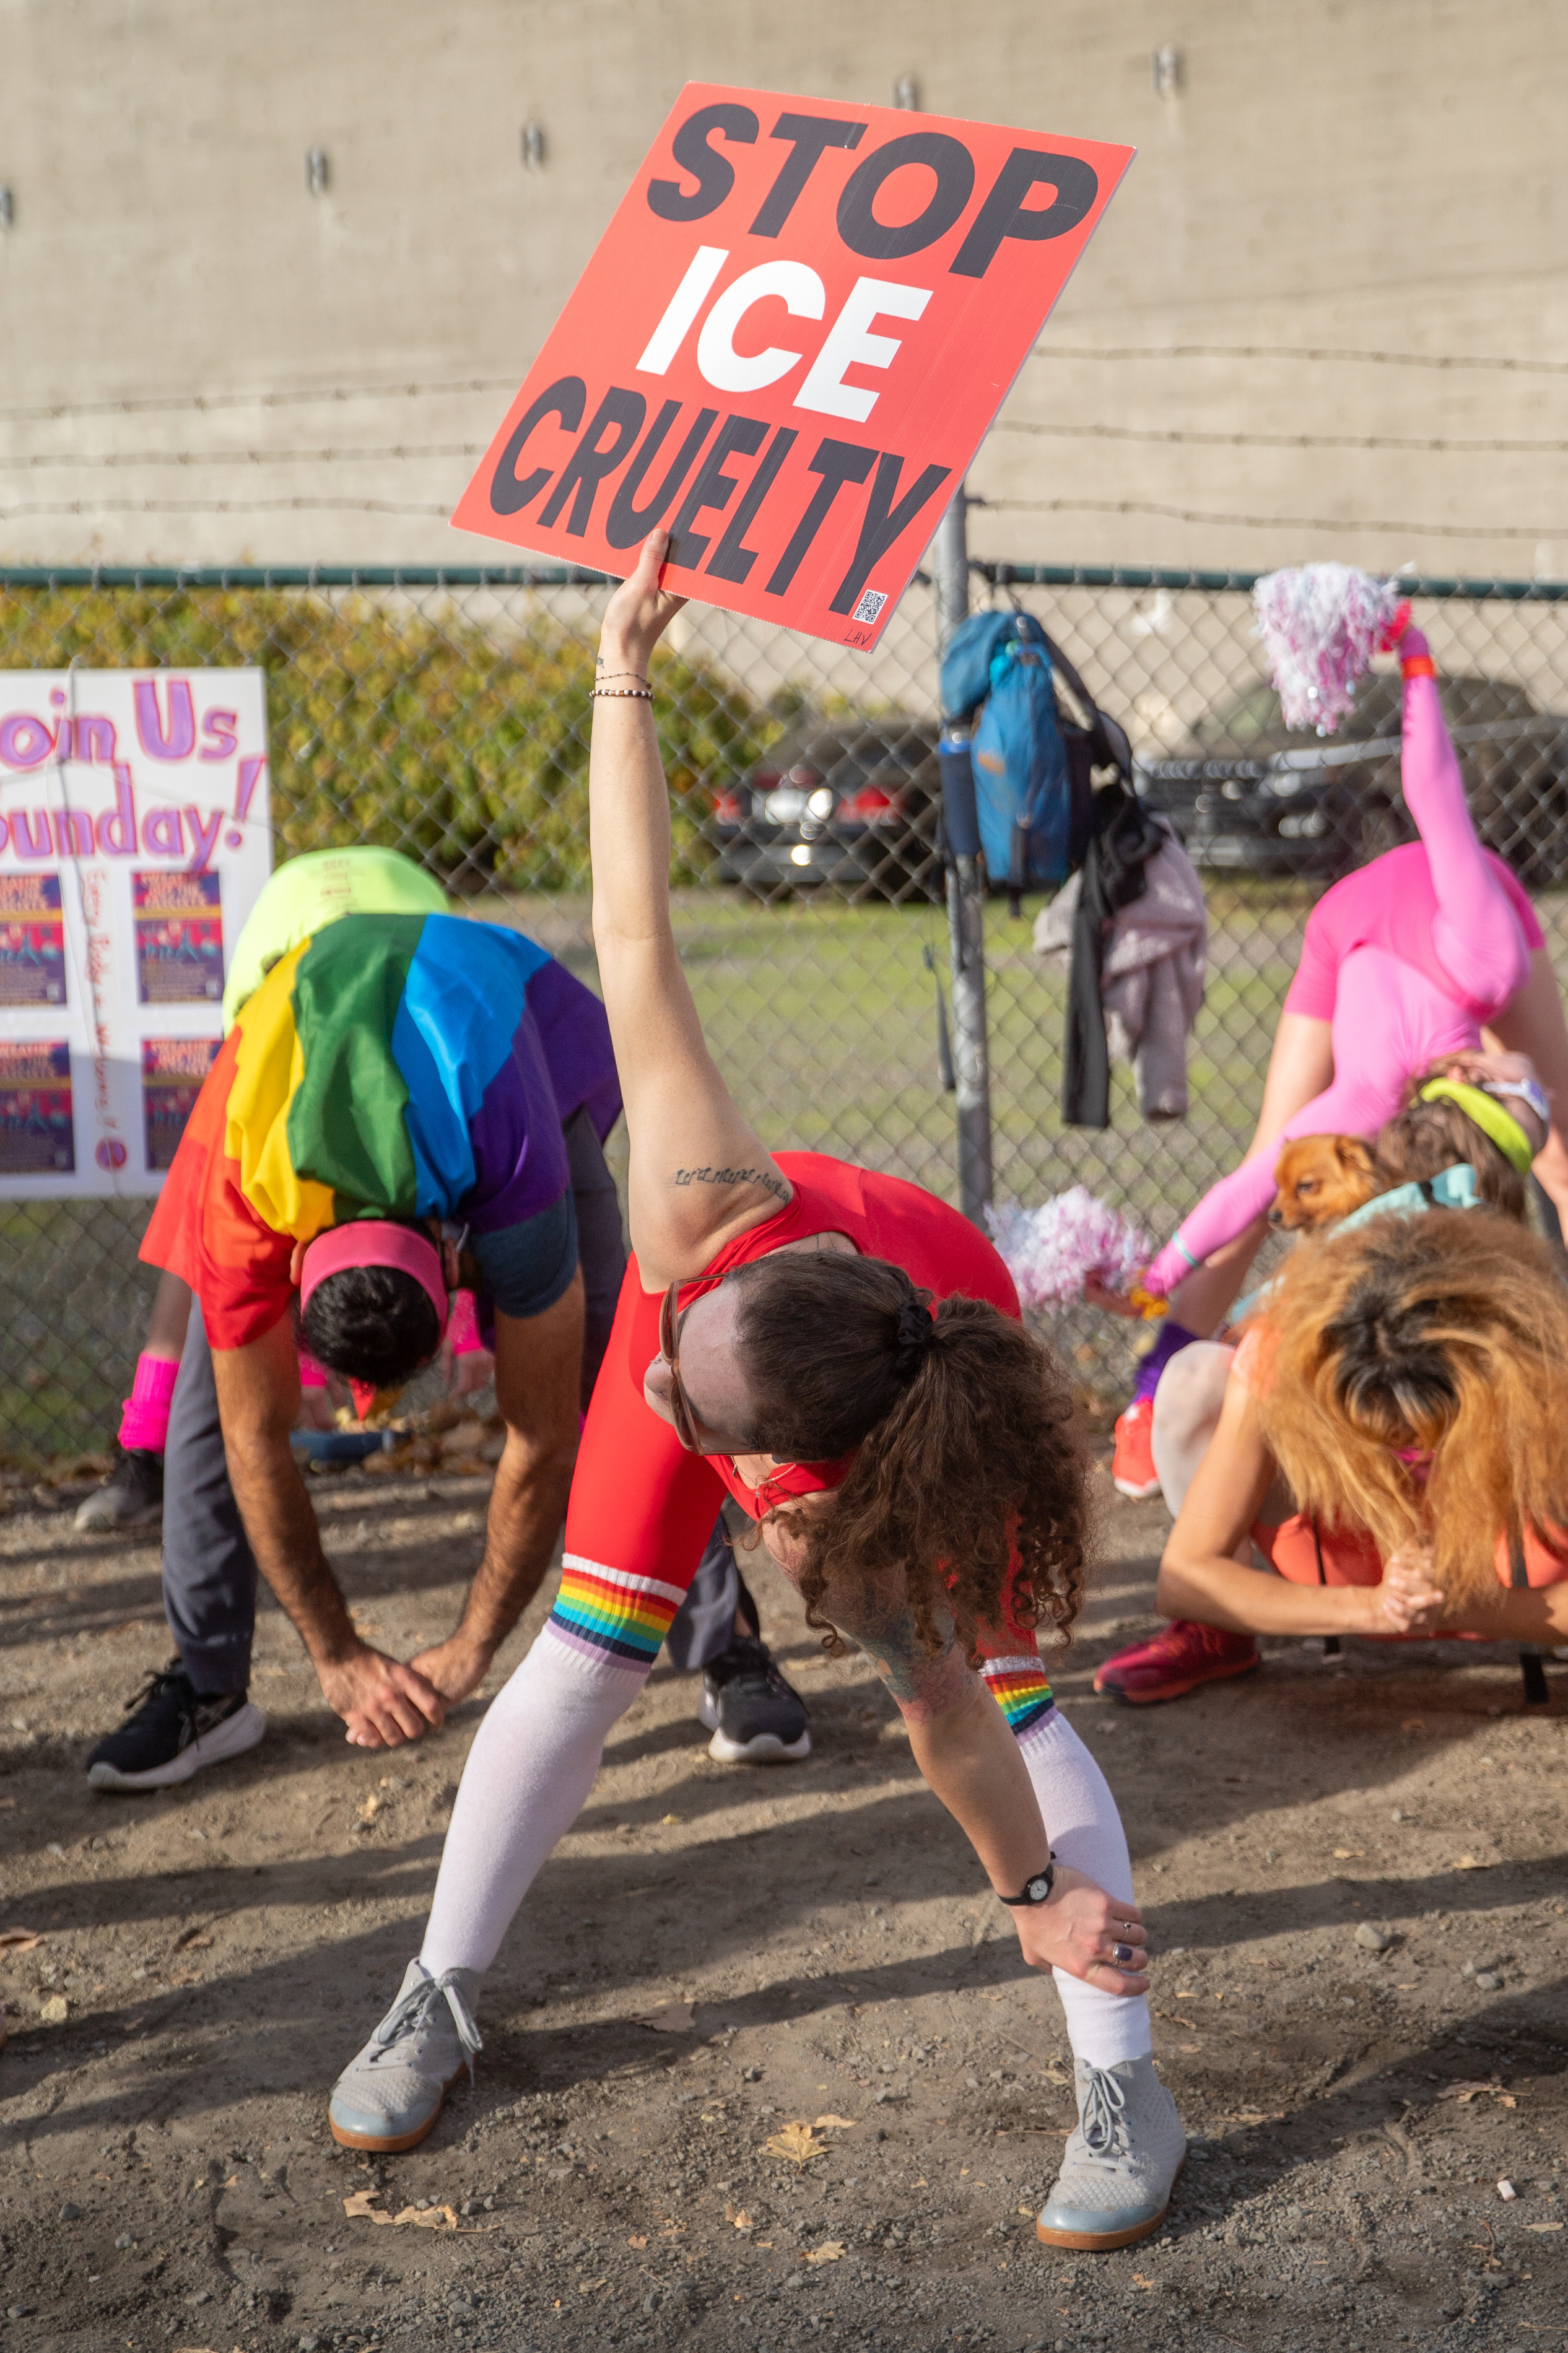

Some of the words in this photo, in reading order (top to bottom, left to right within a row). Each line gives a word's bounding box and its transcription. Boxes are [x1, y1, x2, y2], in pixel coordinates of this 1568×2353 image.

[647, 102, 1099, 279] STOP
[635, 245, 934, 424] ICE
[490, 375, 953, 615] CRUELTY
[132, 675, 238, 762] Us
[0, 753, 268, 880] unday!
